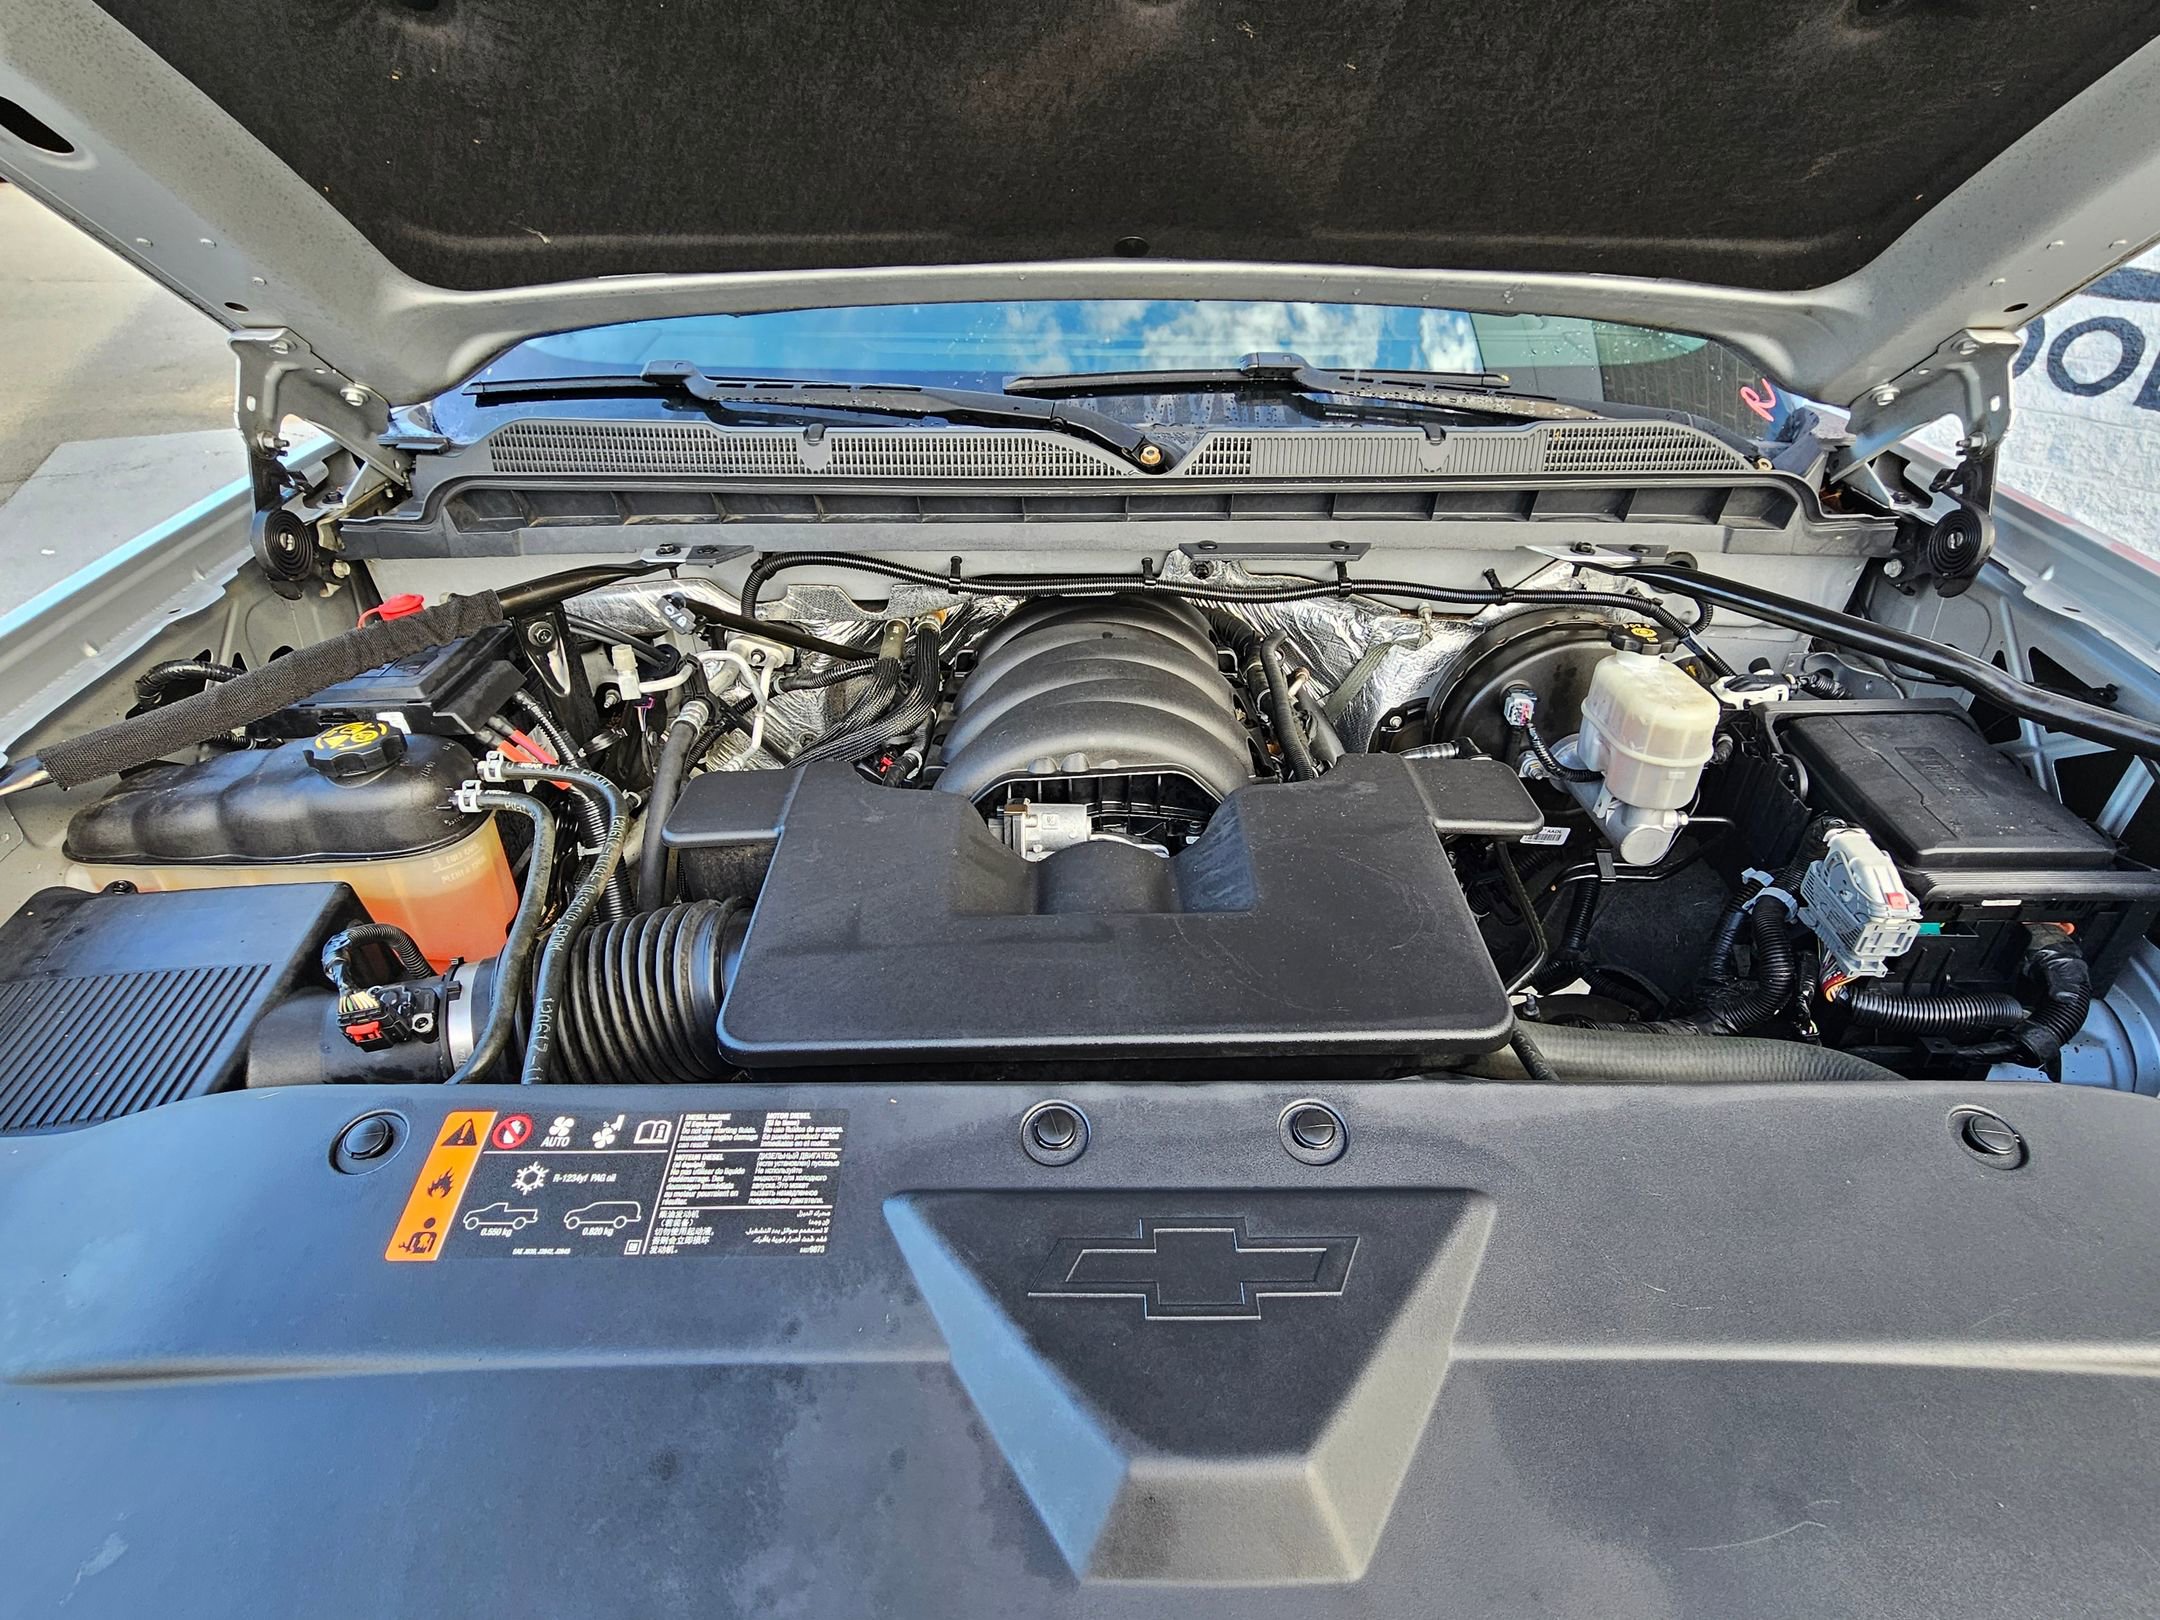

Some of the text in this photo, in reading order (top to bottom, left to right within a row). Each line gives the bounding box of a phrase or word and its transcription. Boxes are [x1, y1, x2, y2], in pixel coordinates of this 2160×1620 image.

[541, 1137, 570, 1147] AUTO
[502, 1227, 512, 1237] kg
[604, 1227, 614, 1237] kg
